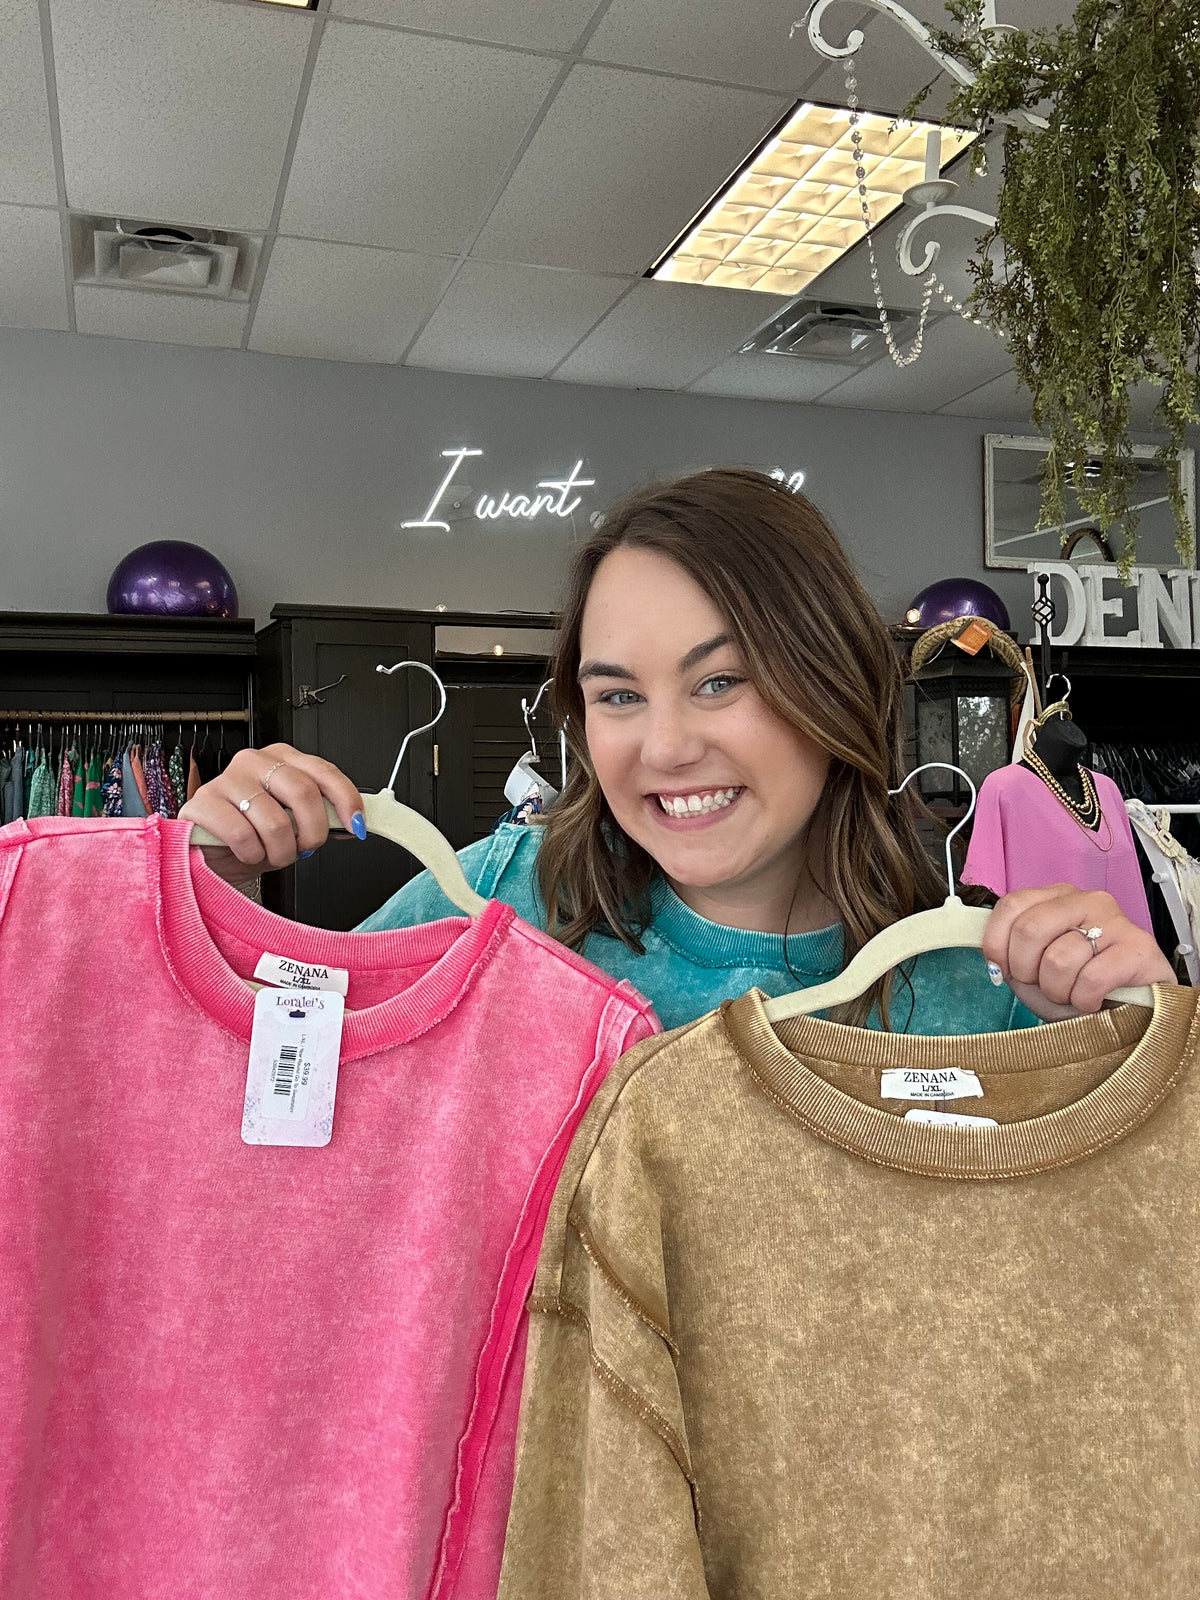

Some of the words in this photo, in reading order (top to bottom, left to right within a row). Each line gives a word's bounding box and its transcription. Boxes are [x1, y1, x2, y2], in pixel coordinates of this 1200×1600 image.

[400, 447, 484, 533] I
[475, 459, 595, 519] want
[278, 959, 328, 979] ZENANA
[292, 975, 312, 985] L/XL
[276, 996, 324, 1010] Loralei's
[301, 1062, 311, 1086] $39.99
[903, 1071, 957, 1083] ZENANA
